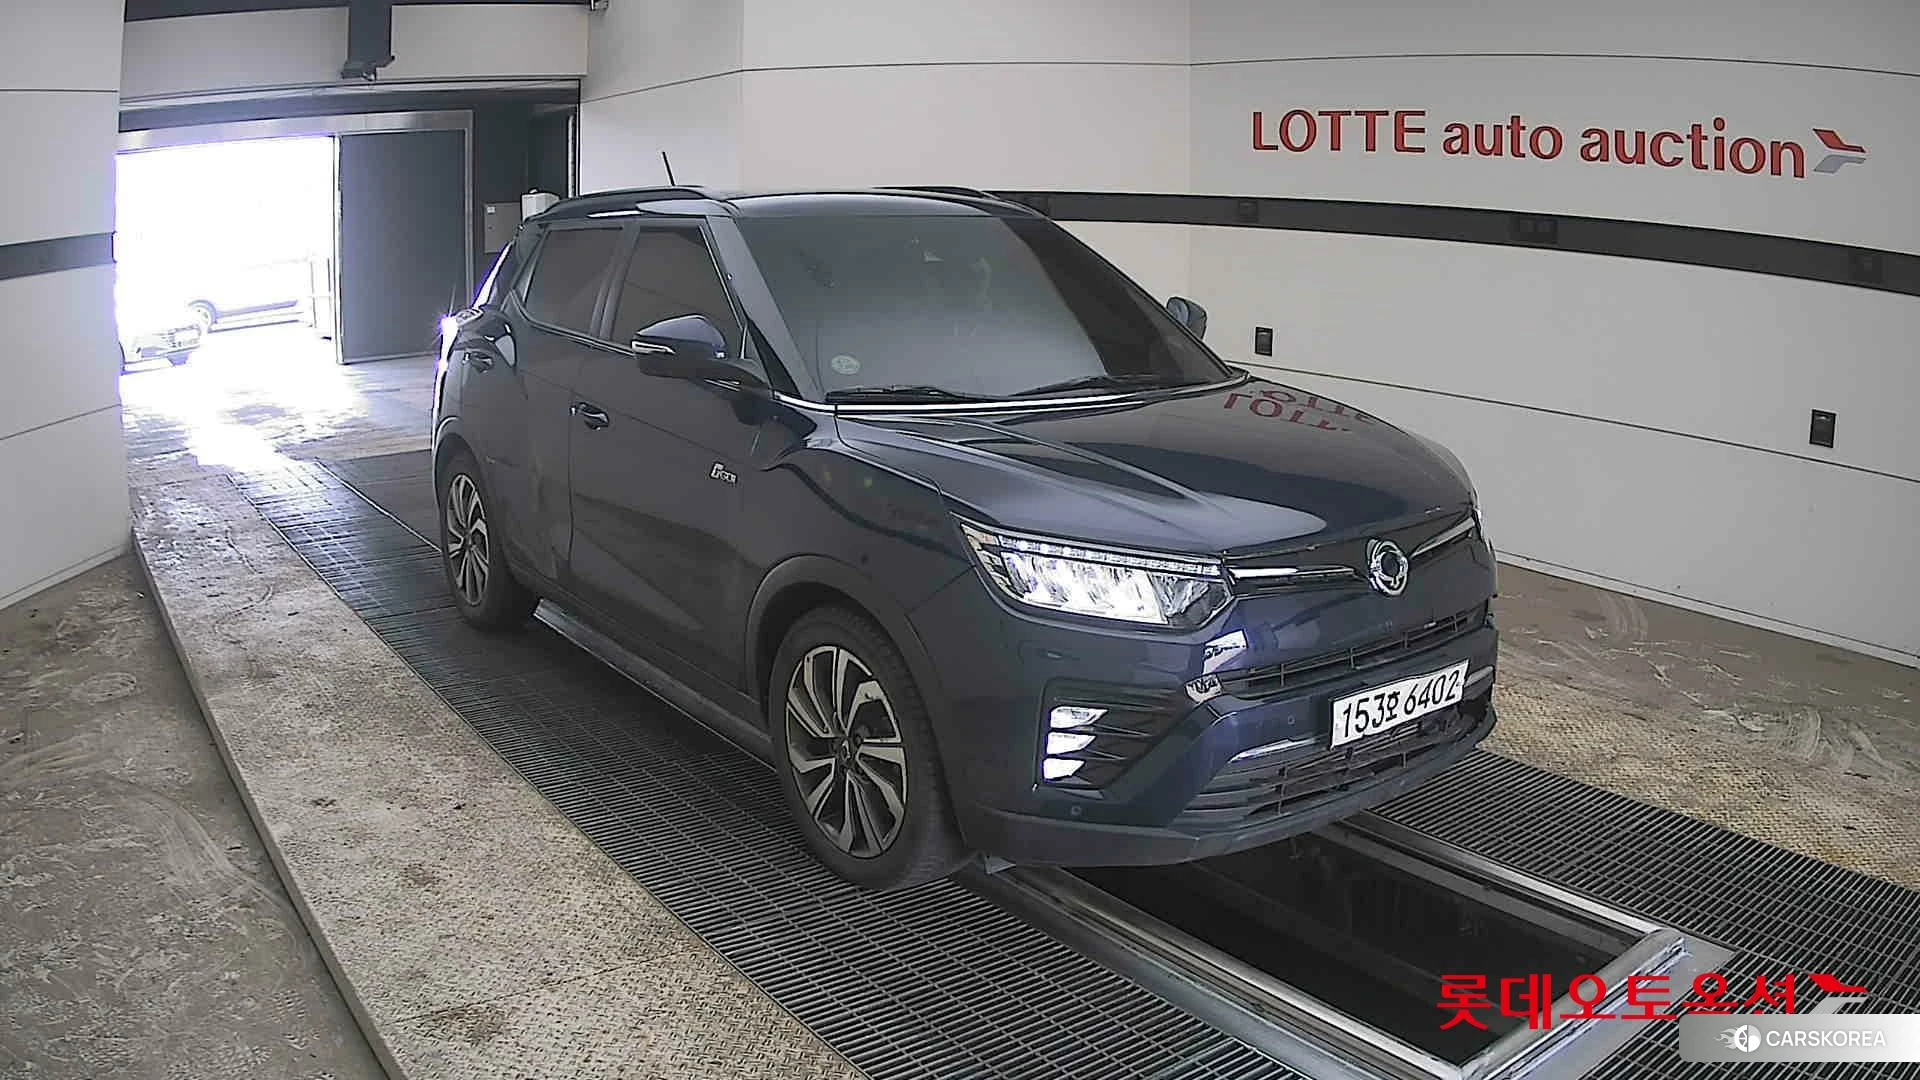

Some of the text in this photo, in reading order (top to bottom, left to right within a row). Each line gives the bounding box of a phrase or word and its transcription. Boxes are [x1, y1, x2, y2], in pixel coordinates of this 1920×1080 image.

[1252, 109, 1806, 179] LOTTE auto auction
[1403, 669, 1460, 716] 6402
